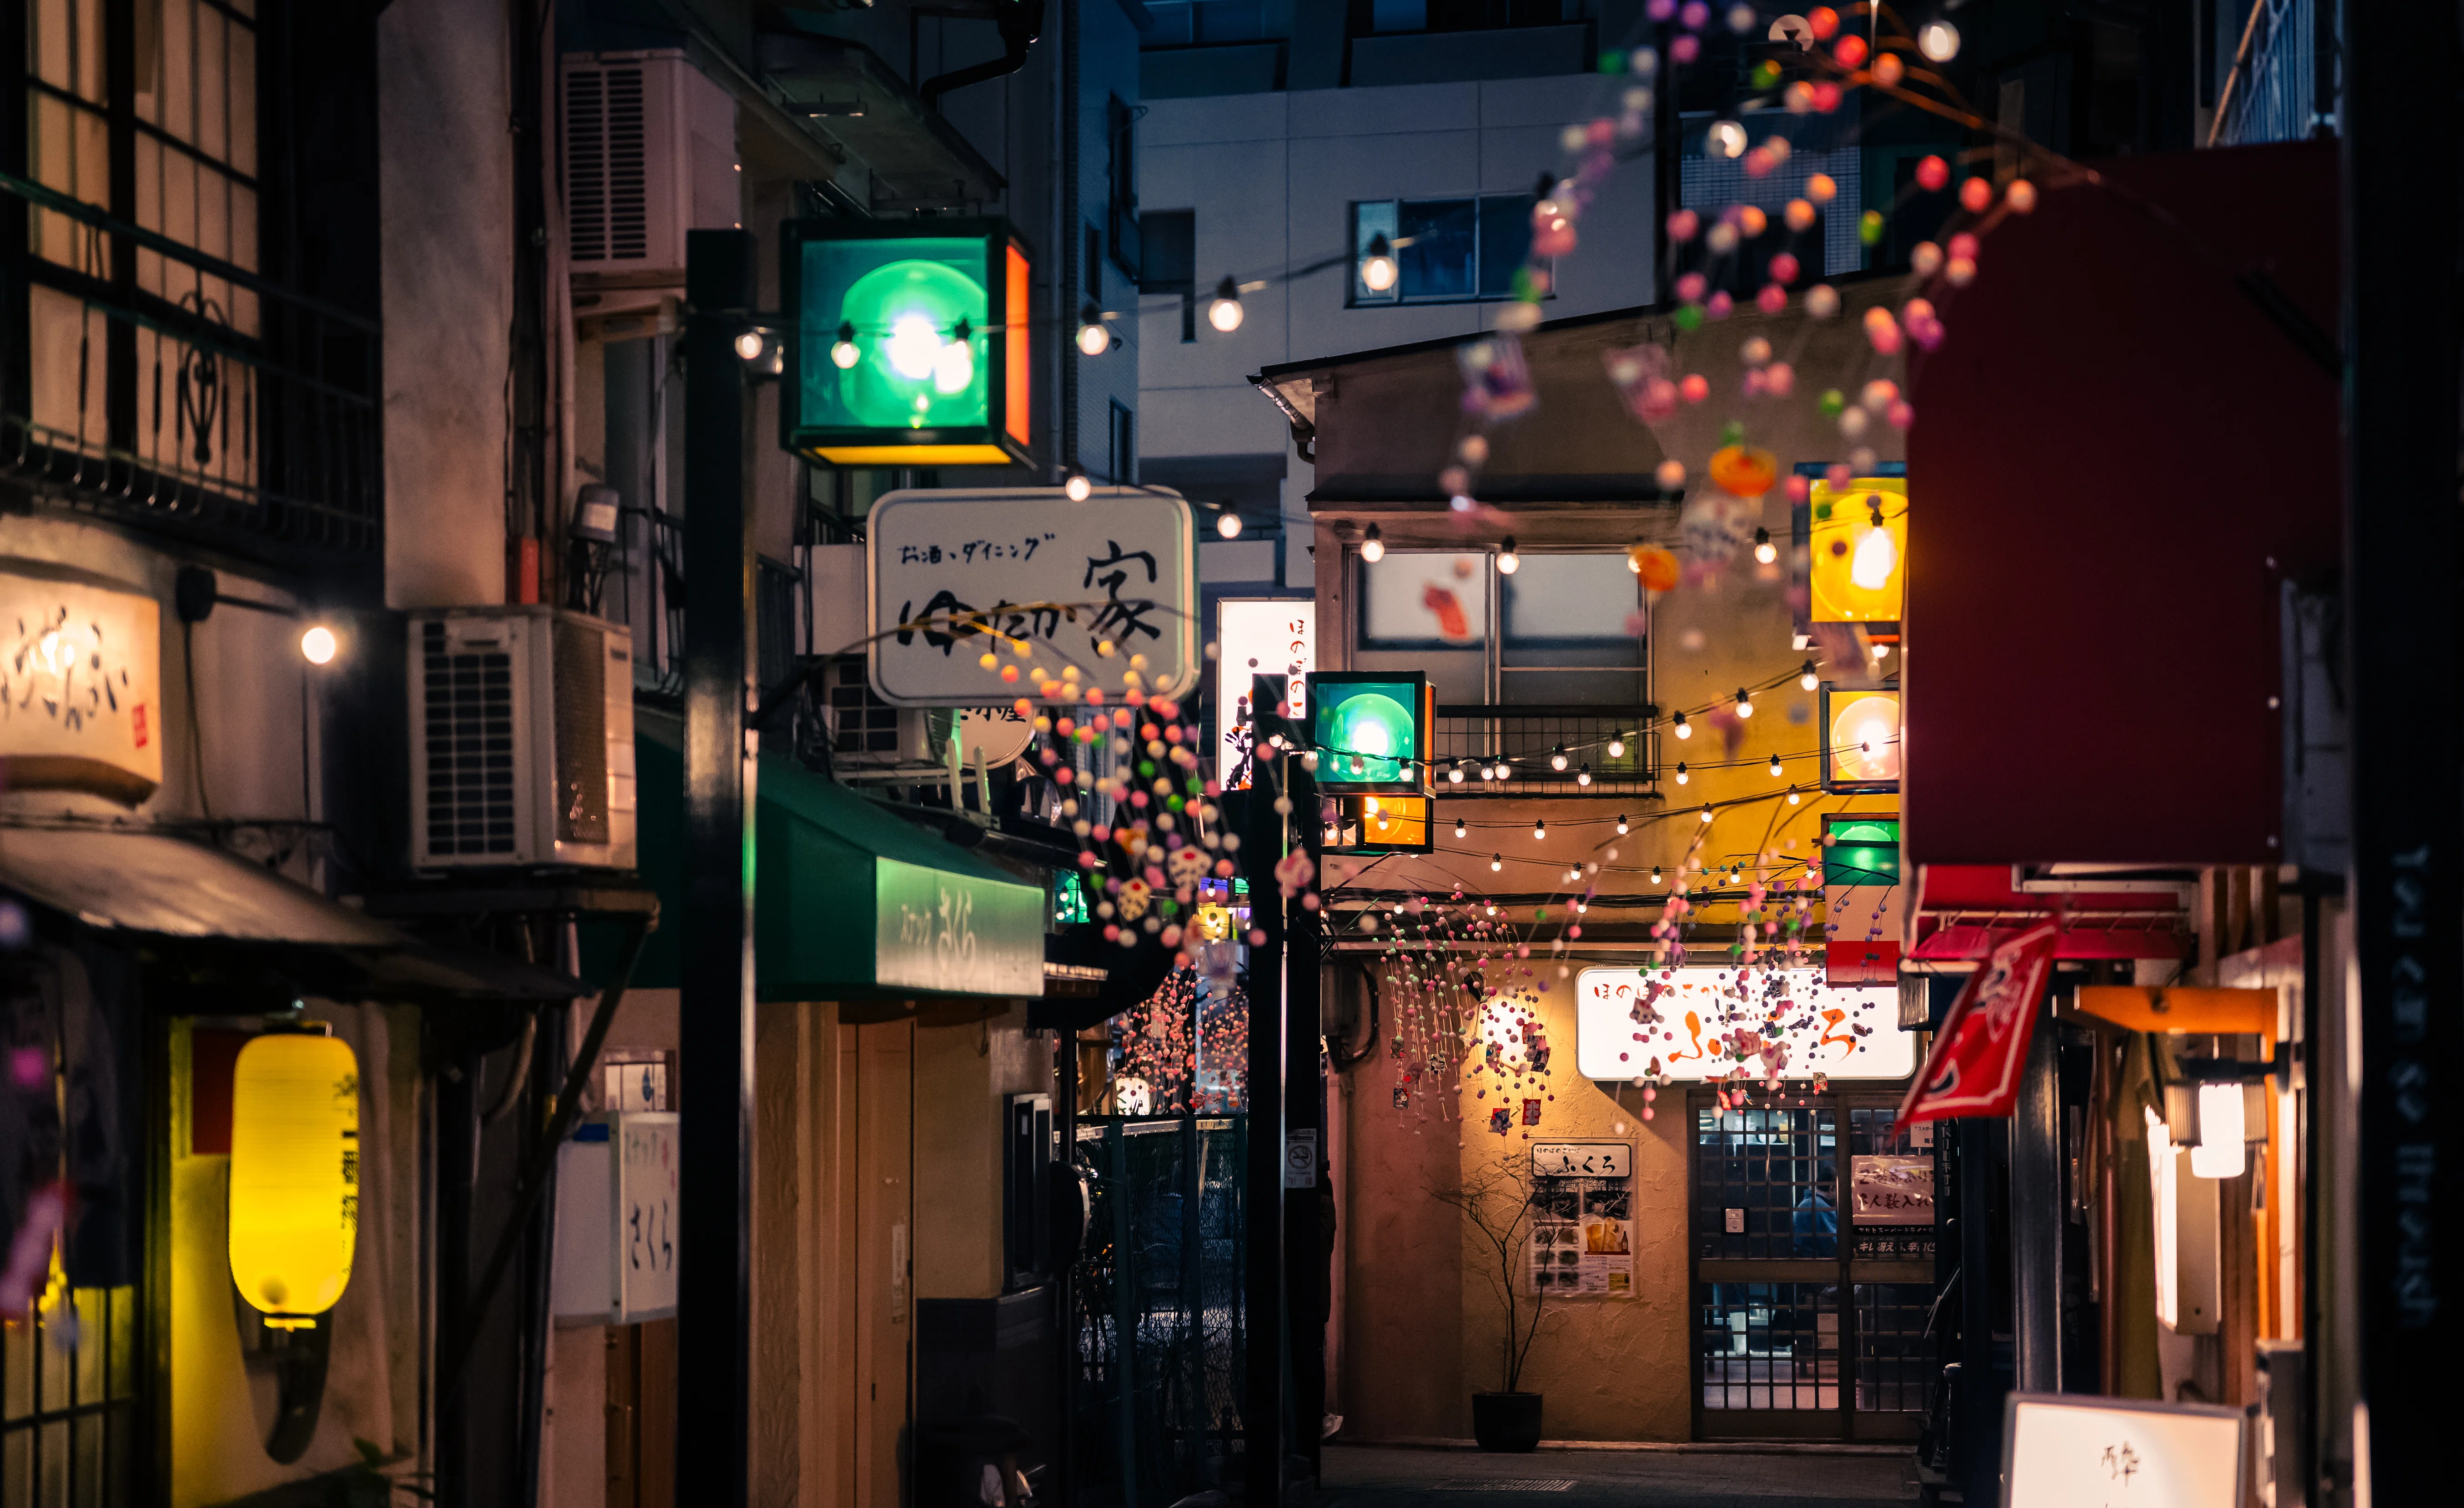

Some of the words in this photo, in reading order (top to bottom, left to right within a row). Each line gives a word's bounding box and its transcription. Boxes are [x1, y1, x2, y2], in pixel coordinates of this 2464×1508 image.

[1557, 1155, 1616, 1175] ふくろ
[1857, 1192, 1934, 1211] 多人数入れ
